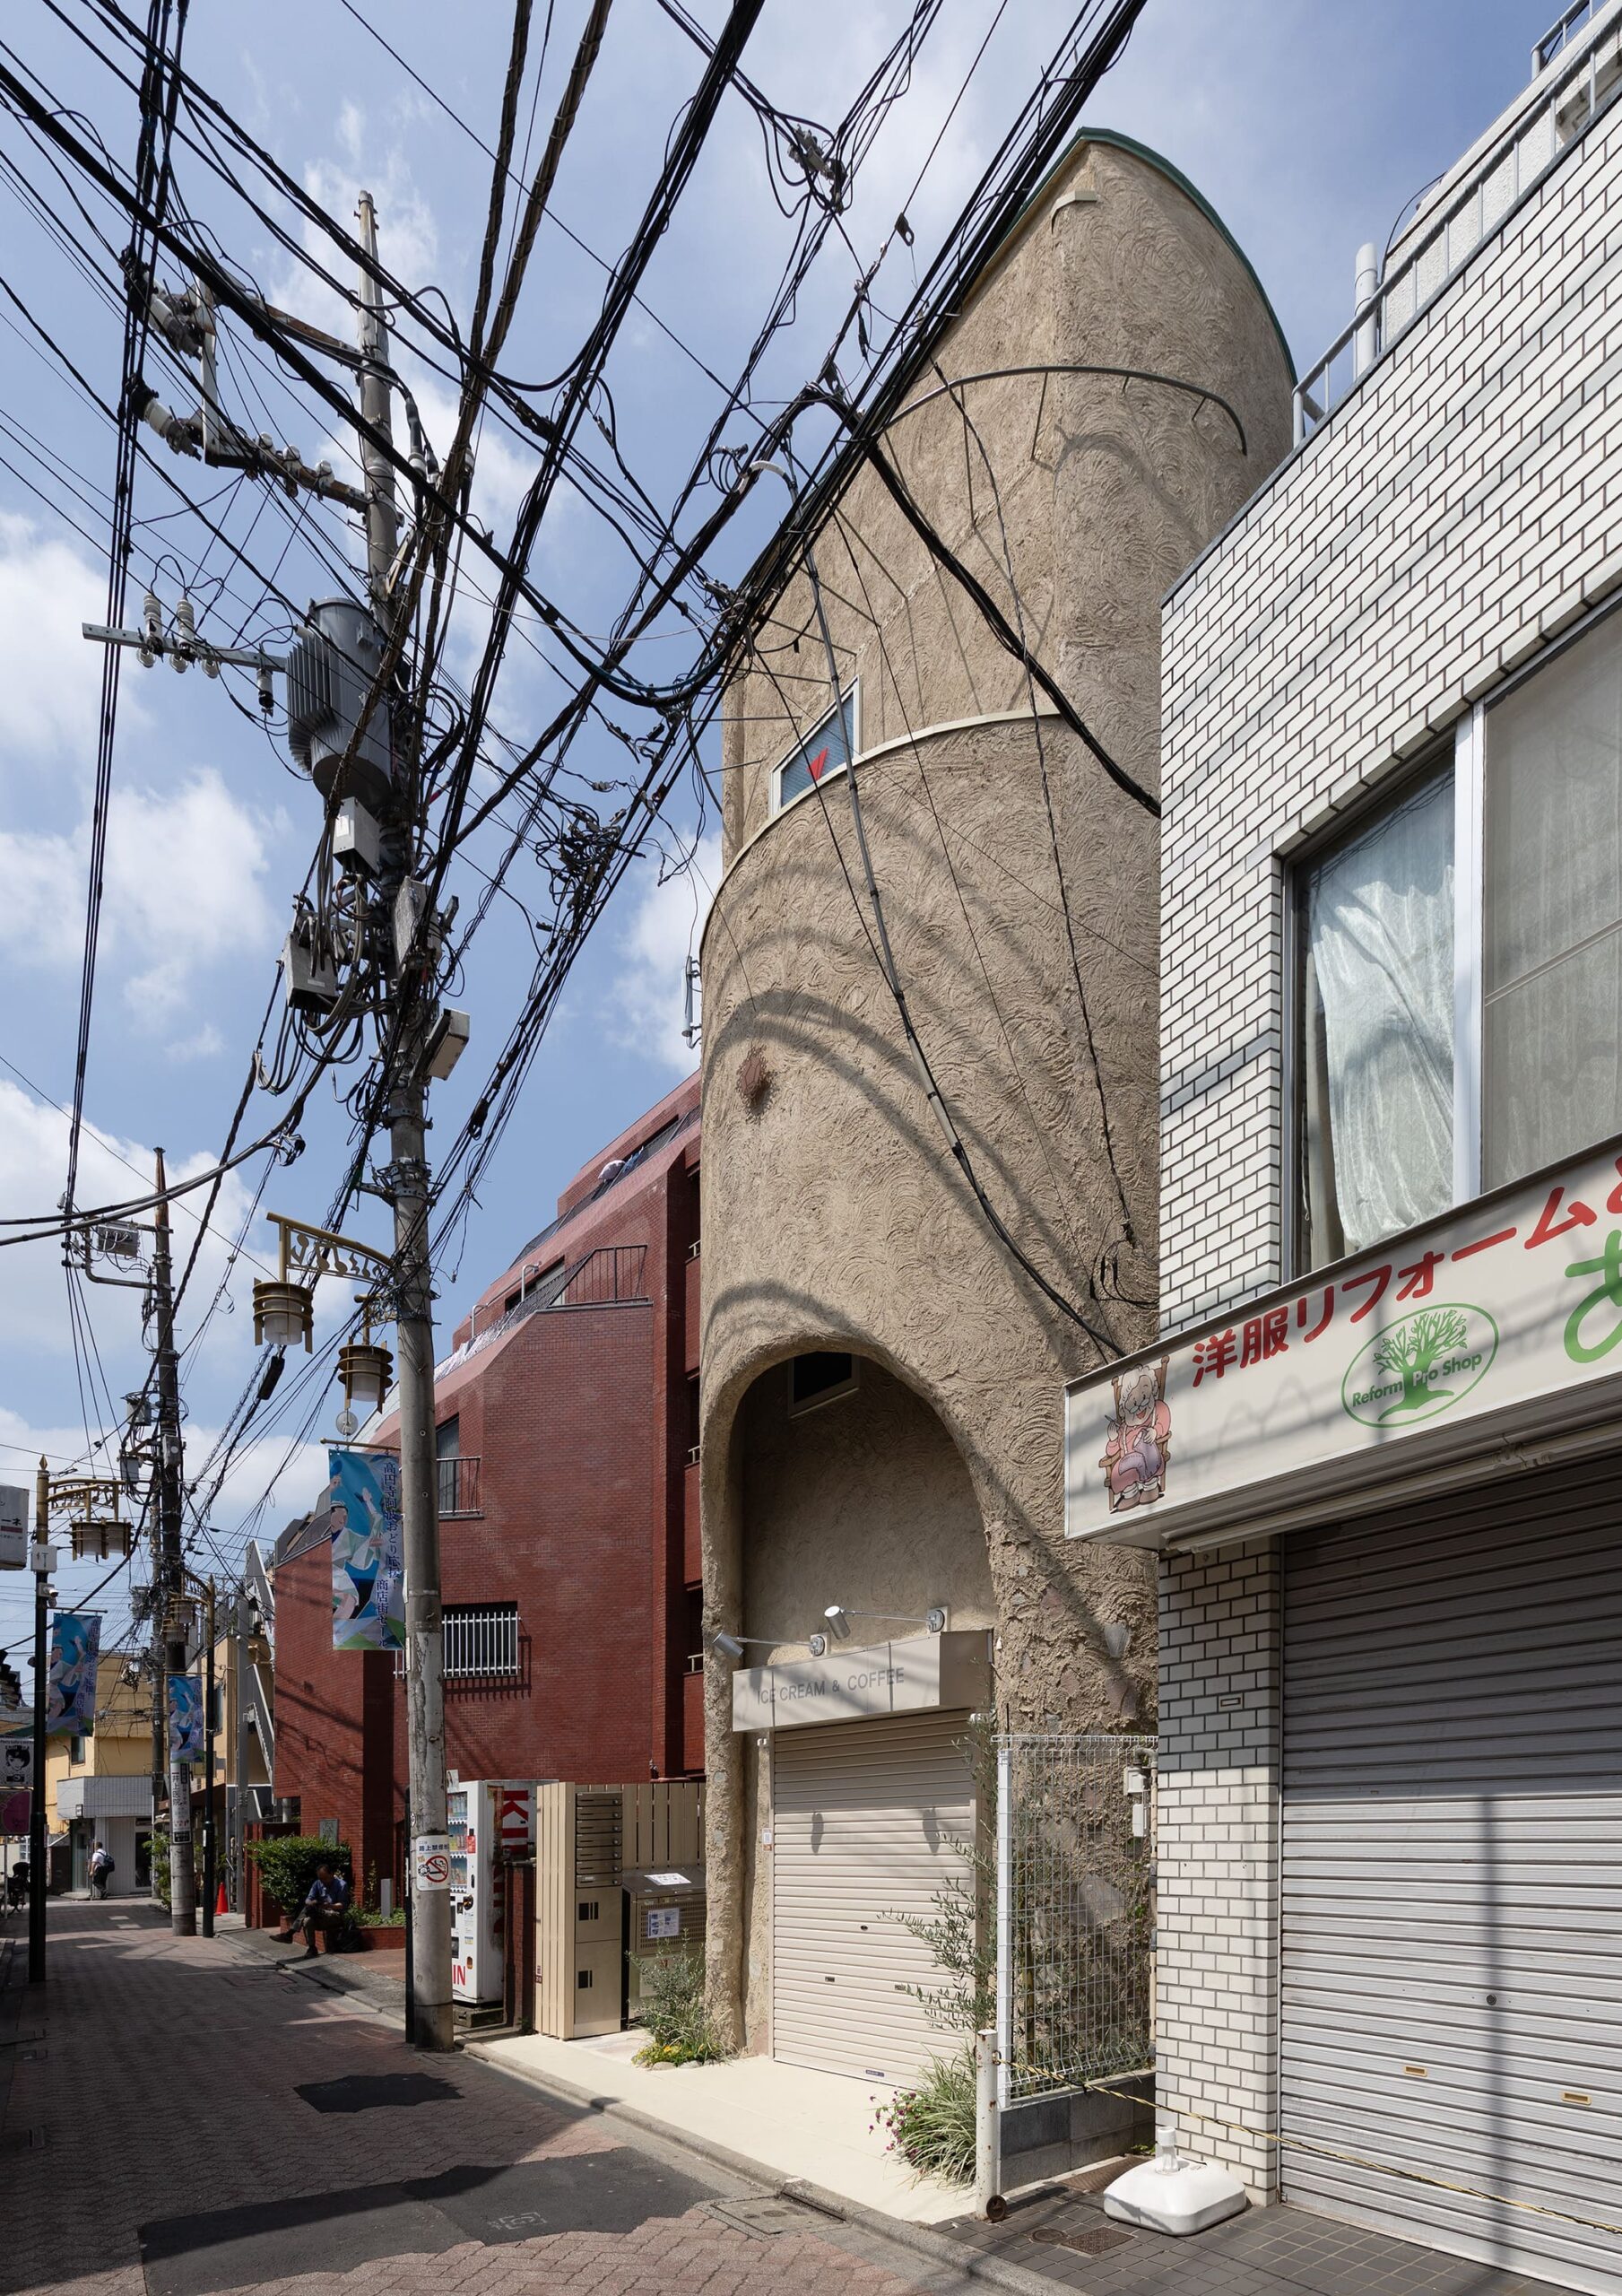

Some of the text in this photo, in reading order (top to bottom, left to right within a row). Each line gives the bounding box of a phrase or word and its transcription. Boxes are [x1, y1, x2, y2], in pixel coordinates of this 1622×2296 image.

[1191, 1156, 1622, 1388] 洋服リフォーム
[1351, 1352, 1482, 1408] Reform Pro Shop
[377, 1579, 388, 1647] 商店街セール
[758, 1667, 905, 1705] ICE CREAM & COFFEE
